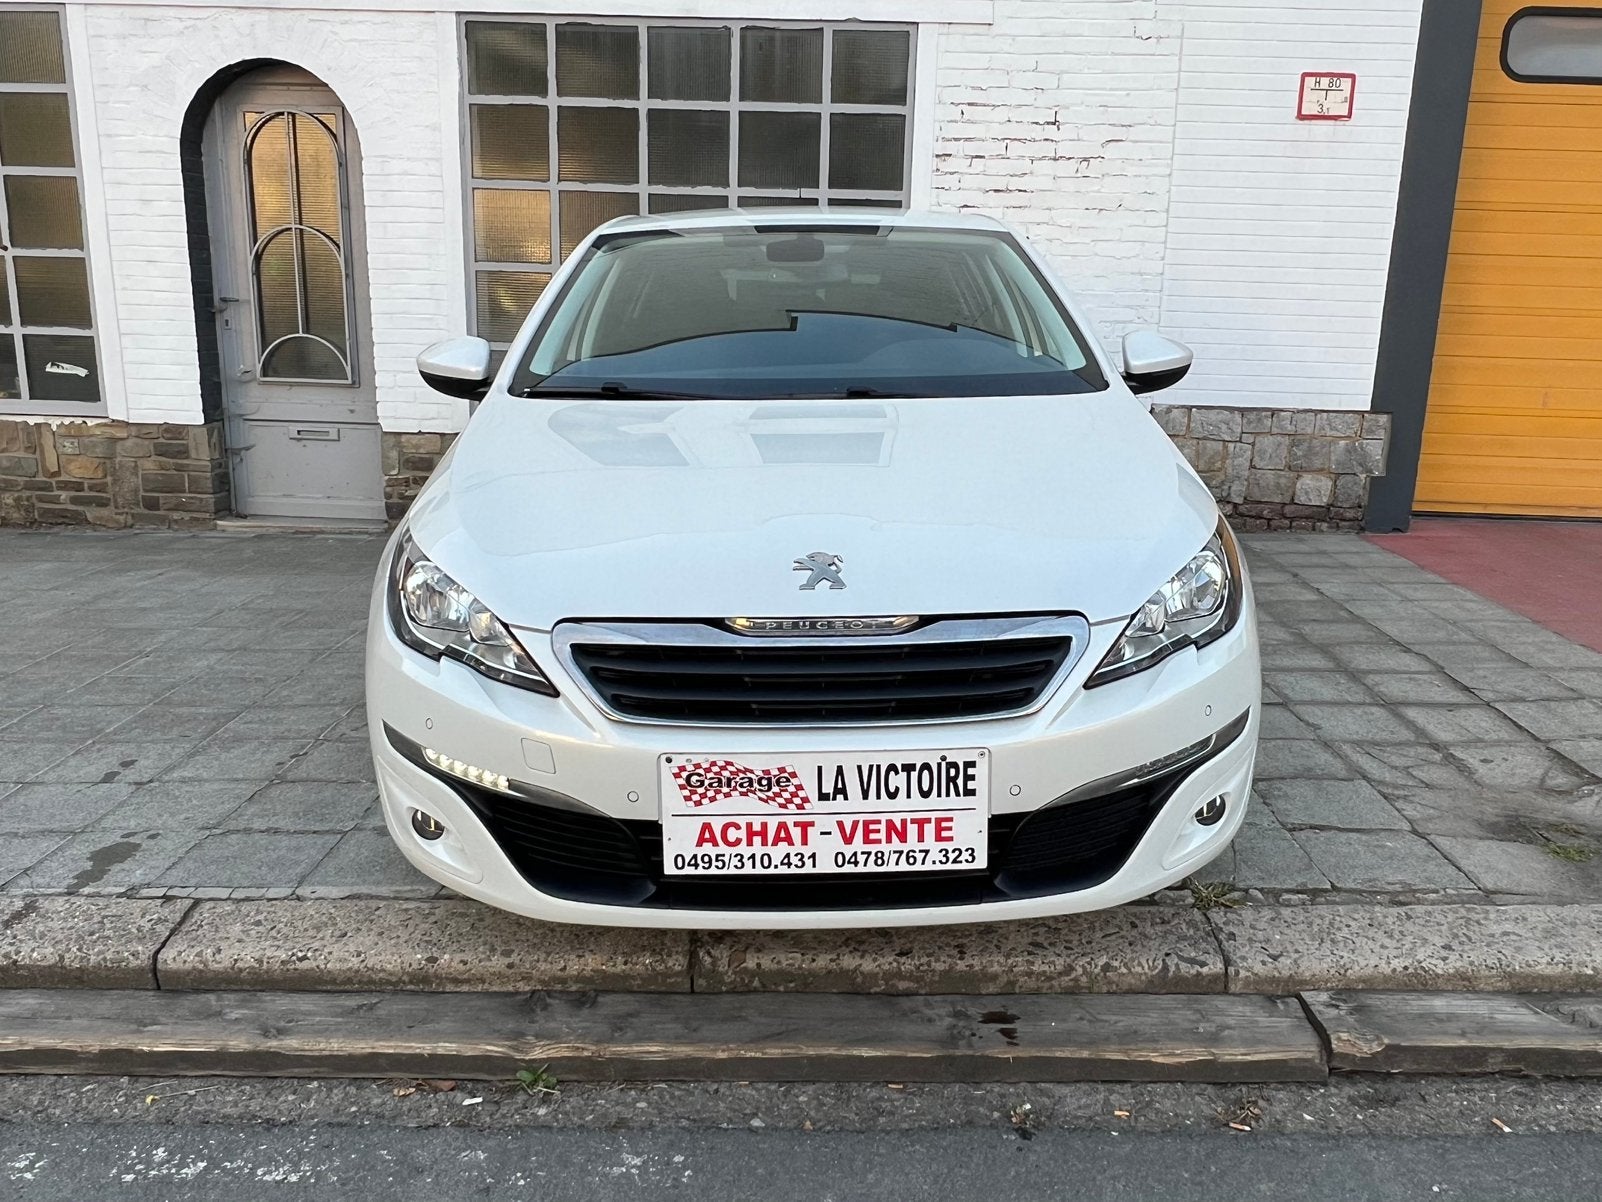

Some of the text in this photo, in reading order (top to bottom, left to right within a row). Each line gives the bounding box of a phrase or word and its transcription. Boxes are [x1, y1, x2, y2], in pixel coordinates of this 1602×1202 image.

[1314, 77, 1342, 88] H 80
[765, 620, 879, 631] PEUGEOT
[684, 760, 977, 801] Garage LA VICTOIRE
[673, 847, 976, 870] 0495/310.431 0478/767.323
